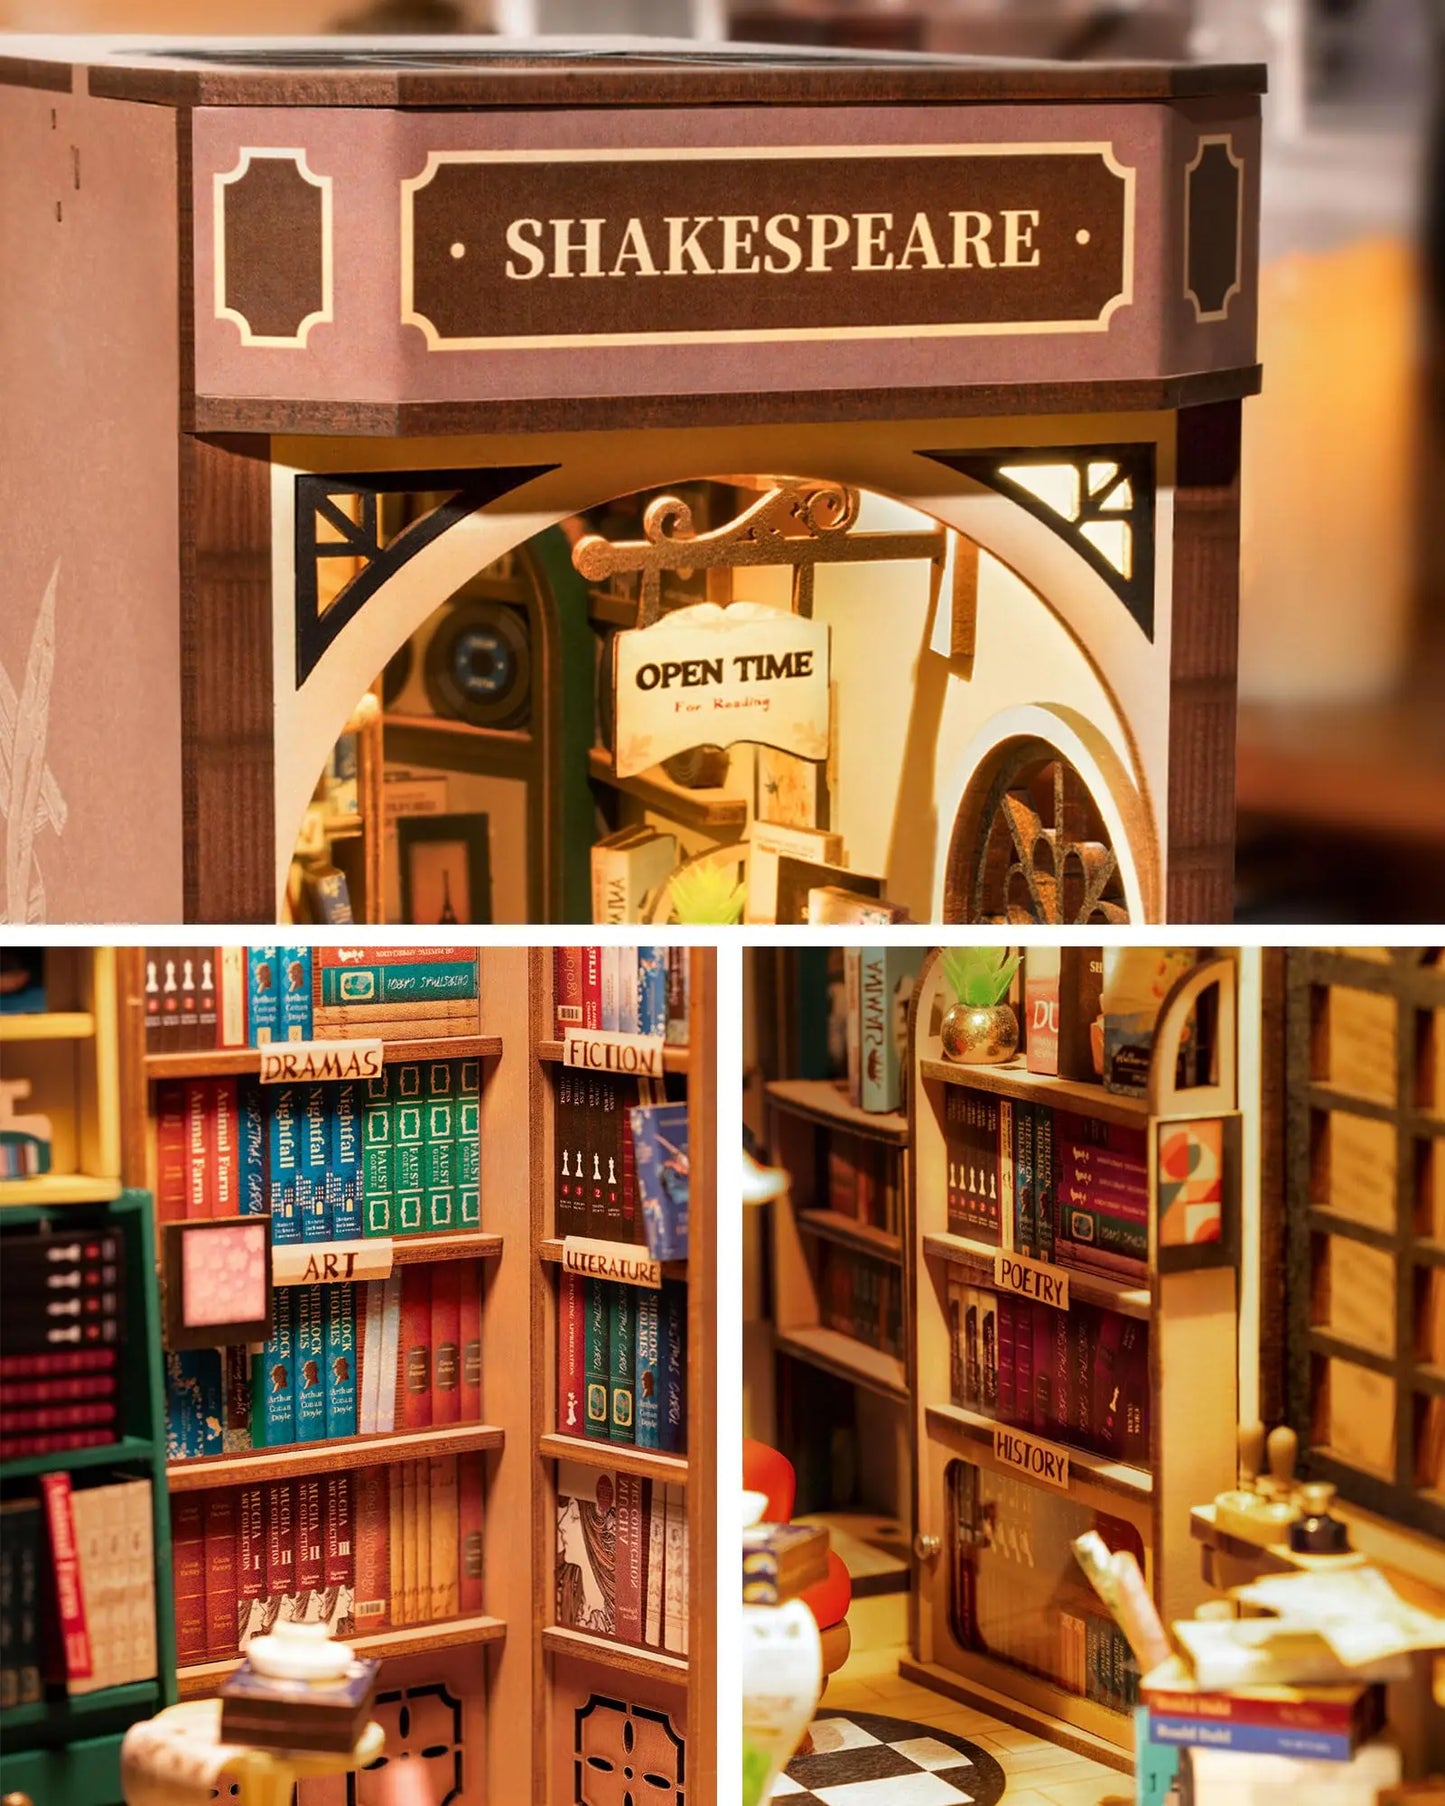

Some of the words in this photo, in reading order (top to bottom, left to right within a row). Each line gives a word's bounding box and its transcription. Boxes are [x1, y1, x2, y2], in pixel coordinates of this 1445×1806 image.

[505, 209, 1040, 280] SHAKESPEARE
[636, 658, 724, 691] OPEN
[733, 651, 814, 682] TIME
[674, 700, 701, 713] For
[713, 697, 770, 712] Reading
[264, 1050, 379, 1081] DRAMAS
[570, 1039, 655, 1075] FICTION
[191, 1090, 206, 1154] Animal
[217, 1089, 231, 1152] Animal
[275, 1089, 295, 1169] Nightfall
[306, 1087, 325, 1167] Nightfall
[336, 1085, 355, 1164] Nightfall
[192, 1156, 206, 1206] Farm
[217, 1155, 231, 1203] Farm
[378, 1150, 387, 1191] FAUST
[410, 1147, 419, 1189] FAUST
[440, 1145, 449, 1186] FAUST
[302, 1252, 359, 1281] ART
[566, 1250, 659, 1284] LITERATURE
[1001, 1258, 1064, 1306] POETRY
[279, 1288, 290, 1359] SHERLOCK
[299, 1294, 310, 1350] HOLMES
[311, 1284, 322, 1356] SHERLOCK
[330, 1290, 341, 1346] HOLMES
[341, 1282, 352, 1352] SHERLOCK
[649, 1295, 658, 1366] SHERLOCK
[996, 1432, 1065, 1483] HISTORY
[241, 1492, 249, 1512] ART
[270, 1488, 278, 1507] ART
[280, 1487, 290, 1536] MUCHA
[299, 1484, 307, 1503] ART
[308, 1483, 320, 1532] MUCHA
[328, 1481, 337, 1498] ART
[338, 1478, 348, 1527] MUCHA
[250, 1490, 261, 1539] MUCHA
[271, 1508, 279, 1566] COLLECTION
[300, 1503, 309, 1562] COLLECTION
[329, 1499, 338, 1558] COLLECTION
[242, 1513, 251, 1571] COLLECTION
[253, 1555, 260, 1570] I
[281, 1550, 292, 1565] II
[309, 1545, 320, 1561] II
[362, 1523, 379, 1593] Mythology
